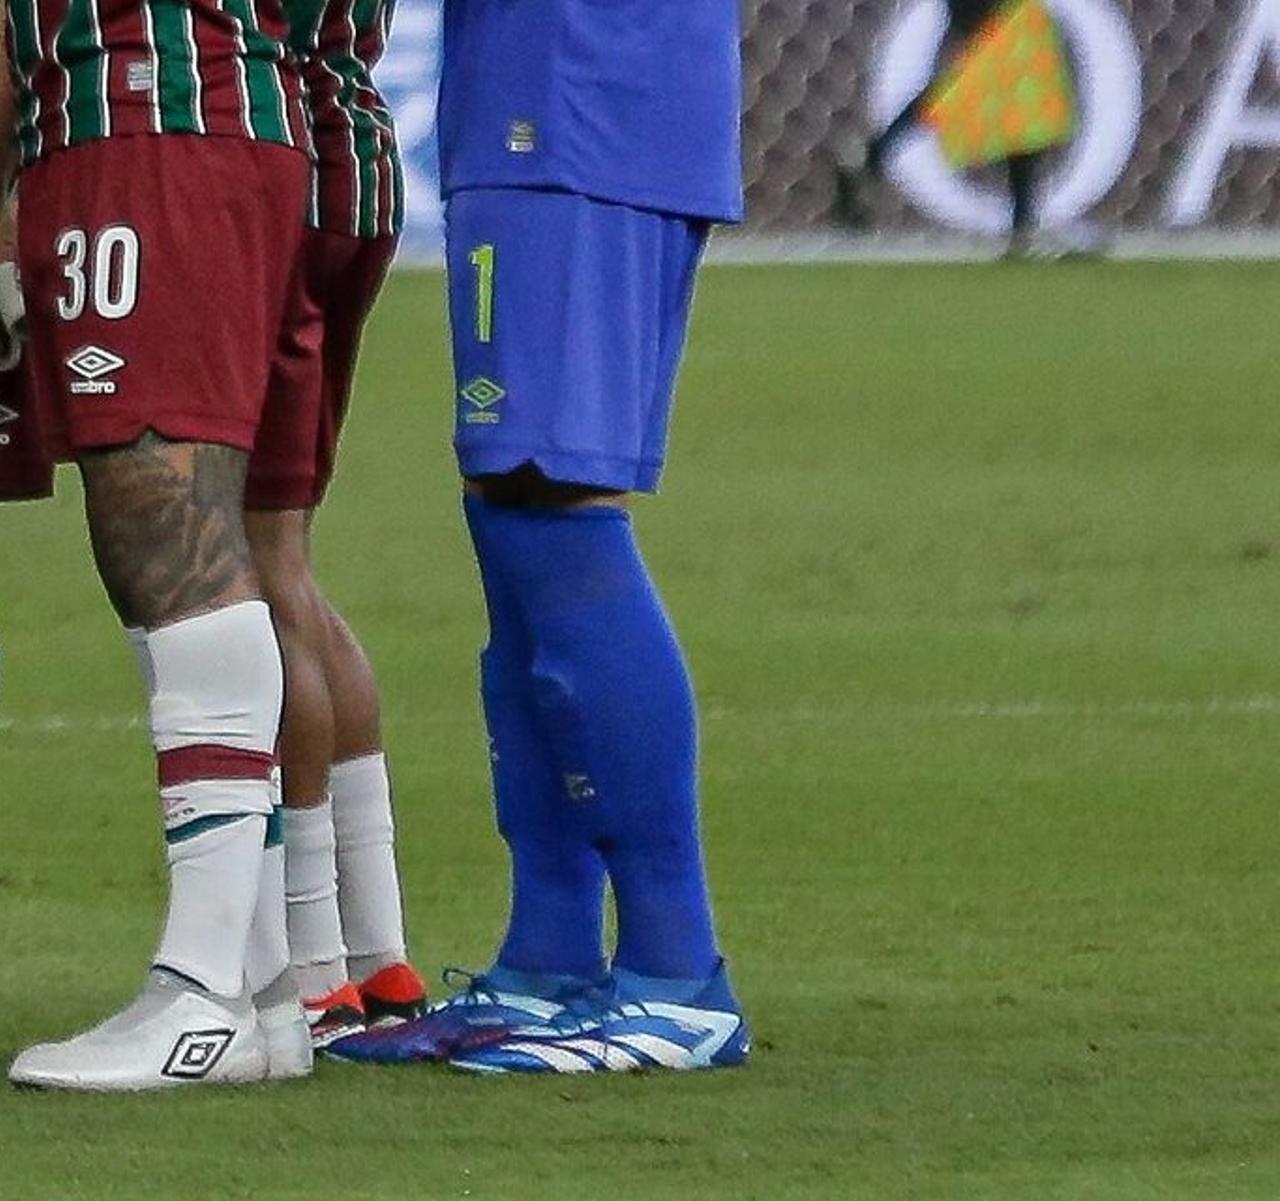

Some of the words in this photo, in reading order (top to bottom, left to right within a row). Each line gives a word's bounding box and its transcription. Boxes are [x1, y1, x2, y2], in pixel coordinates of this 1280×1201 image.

[57, 226, 139, 319] 30
[469, 244, 494, 343] 1
[69, 380, 116, 395] umbro
